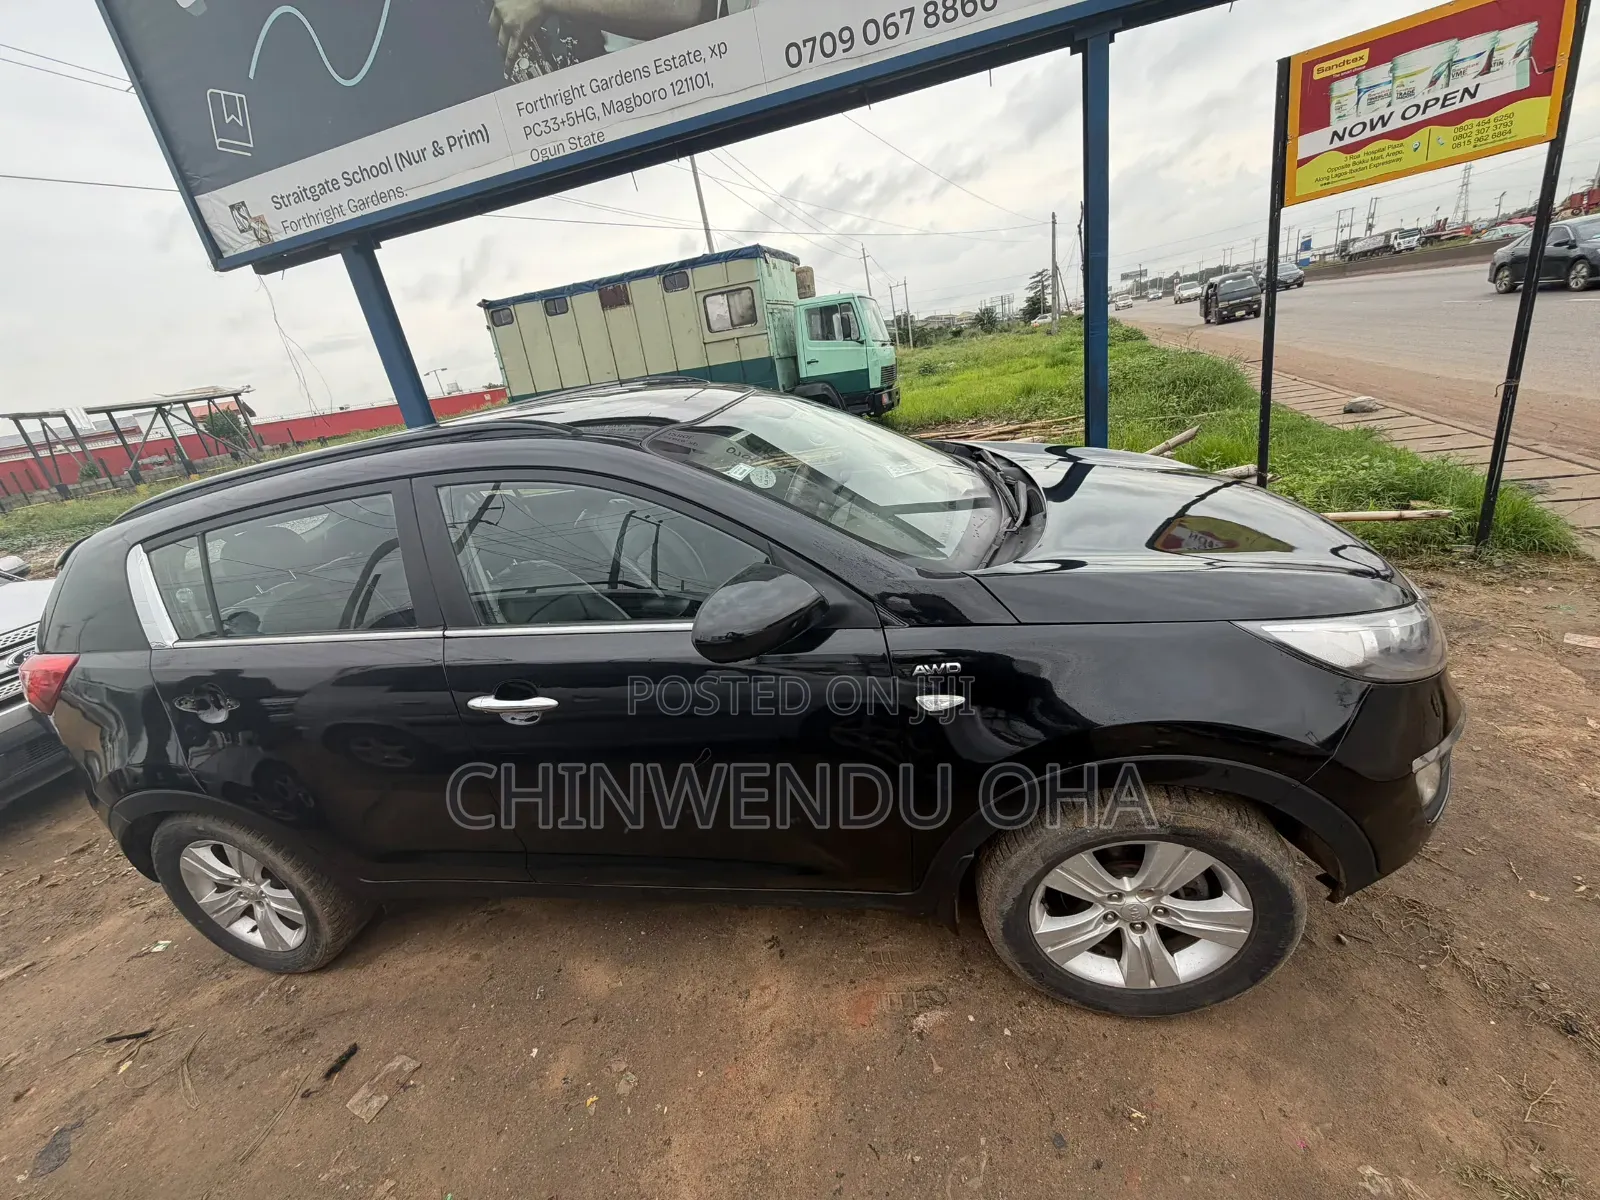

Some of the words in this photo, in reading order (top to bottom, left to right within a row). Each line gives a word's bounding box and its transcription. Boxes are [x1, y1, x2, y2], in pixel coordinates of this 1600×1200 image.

[785, 26, 855, 69] 0709
[862, 6, 916, 46] 067
[1316, 54, 1365, 75] Sandtex
[516, 83, 587, 117] Forthright
[589, 65, 651, 94] Gardens
[653, 48, 706, 75] Estate,
[708, 41, 728, 59] xp
[523, 105, 600, 140] PC33+5HG,
[601, 87, 668, 117] Magboro
[670, 71, 714, 97] 121101,
[1329, 110, 1395, 145] NOW
[1401, 83, 1481, 121] OPEN
[1452, 131, 1473, 142] 0802
[1475, 126, 1491, 136] 307
[1492, 120, 1514, 132] 3793
[1453, 122, 1474, 134] 0803
[1475, 118, 1491, 127] 454
[530, 142, 566, 162] Ogun
[568, 130, 605, 151] State
[1451, 139, 1472, 150] 0815
[1473, 134, 1490, 144] 962
[1491, 128, 1512, 140] 6864
[1363, 145, 1387, 157] Hospital
[271, 178, 341, 211] Straitgate
[341, 156, 394, 187] School
[394, 149, 427, 173] (Nur
[432, 140, 445, 158] &
[446, 123, 490, 153] Prim)
[1326, 163, 1351, 174] Opposite
[1314, 174, 1330, 183] Along
[281, 202, 346, 235] Forthright
[347, 185, 408, 214] Gardens.
[912, 662, 961, 676] AWD
